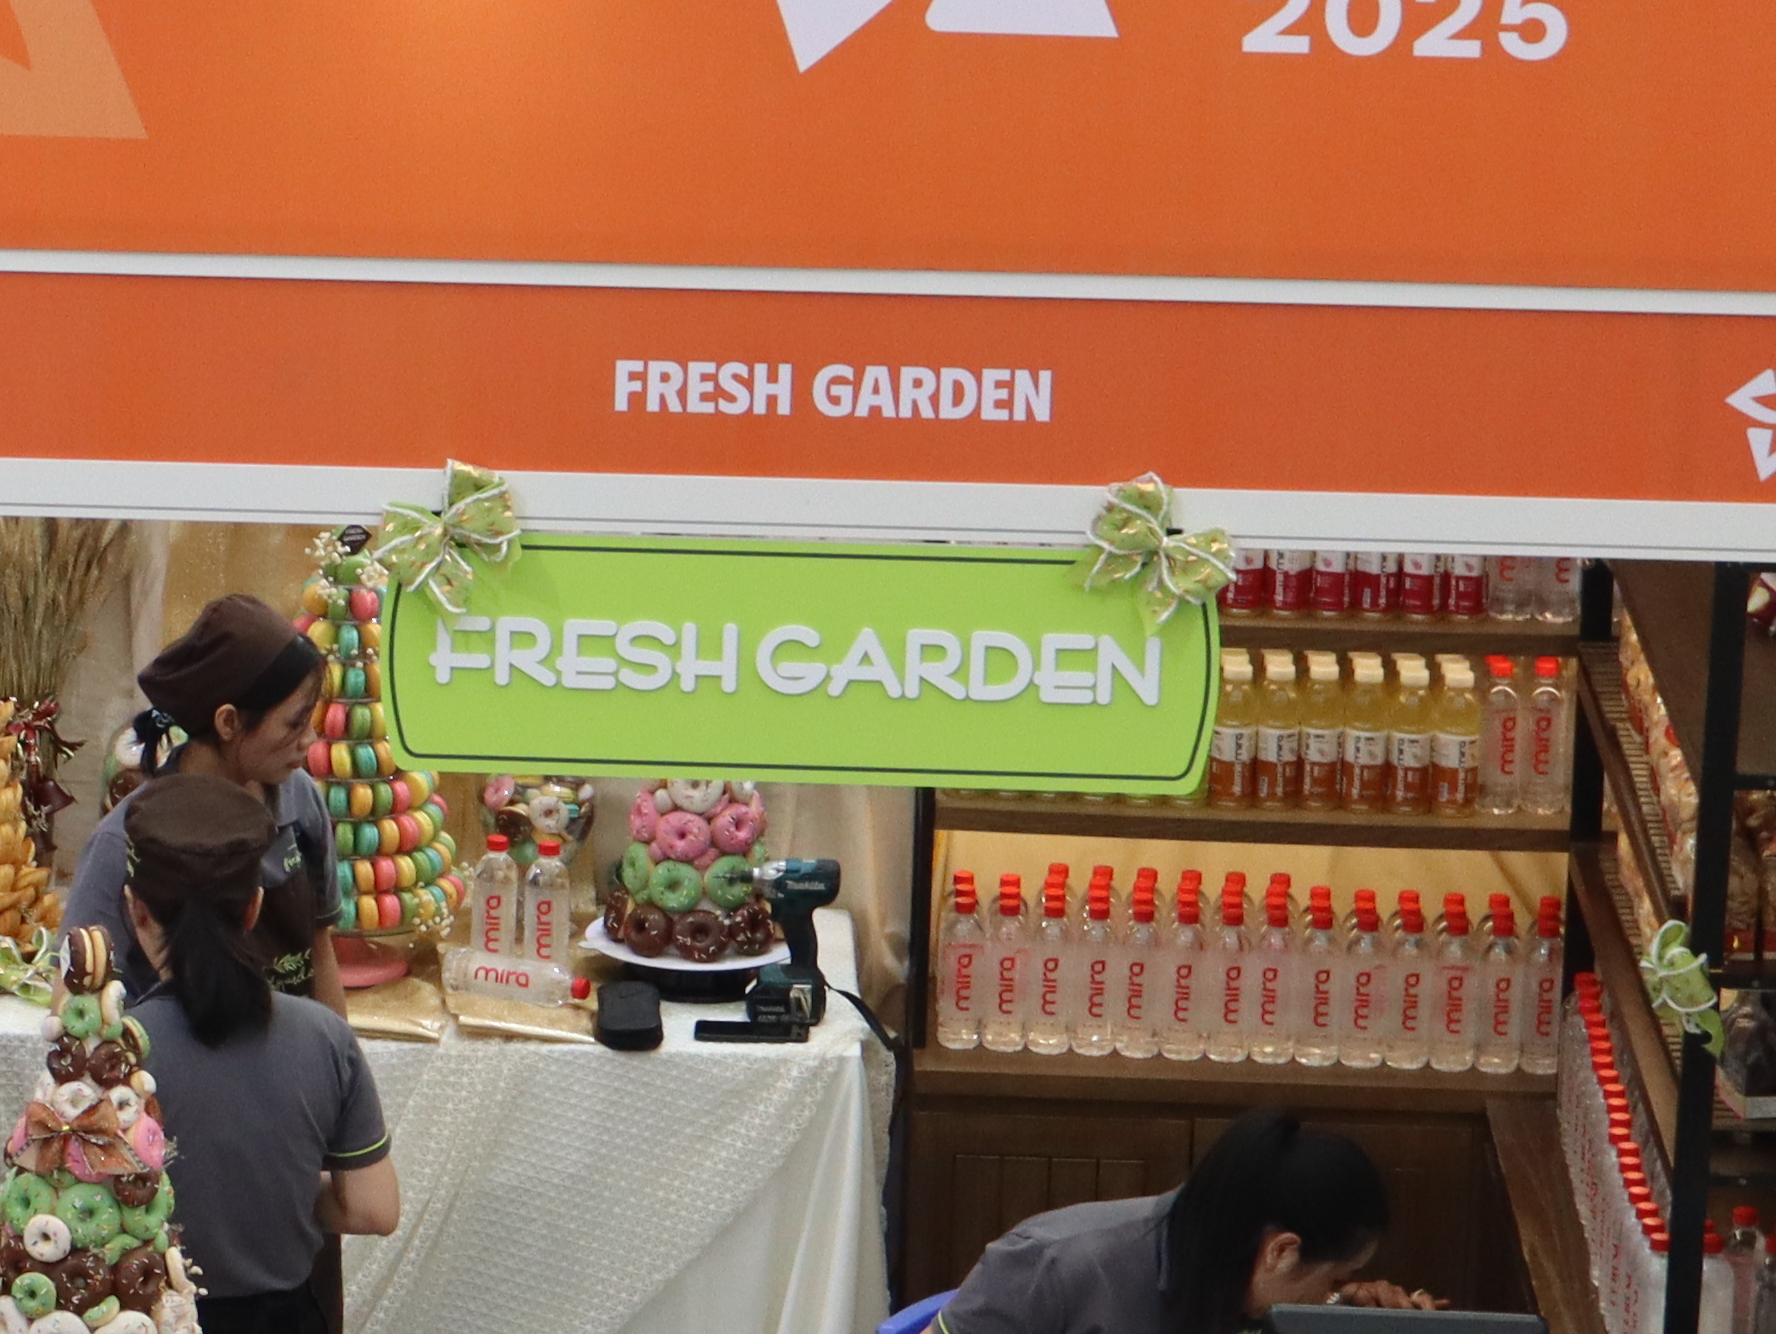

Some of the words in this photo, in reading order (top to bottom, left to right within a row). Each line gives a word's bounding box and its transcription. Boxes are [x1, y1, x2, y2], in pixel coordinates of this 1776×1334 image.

[613, 360, 791, 416] FRESH
[811, 364, 1053, 423] GARDEN
[427, 616, 739, 695] FRESH
[755, 624, 1162, 708] GARDEN
[1499, 715, 1517, 776] mira
[1532, 715, 1553, 777] mira
[483, 894, 502, 953] mira
[535, 899, 553, 960] mira
[474, 965, 530, 989] mira
[955, 954, 973, 1011] mira
[998, 956, 1015, 1015] mira
[1088, 959, 1106, 1018] mira
[1173, 964, 1192, 1023] mira
[1261, 967, 1279, 1026] mira
[1354, 971, 1371, 1030] mira
[1446, 975, 1463, 1034] mira
[1536, 977, 1555, 1037] mira
